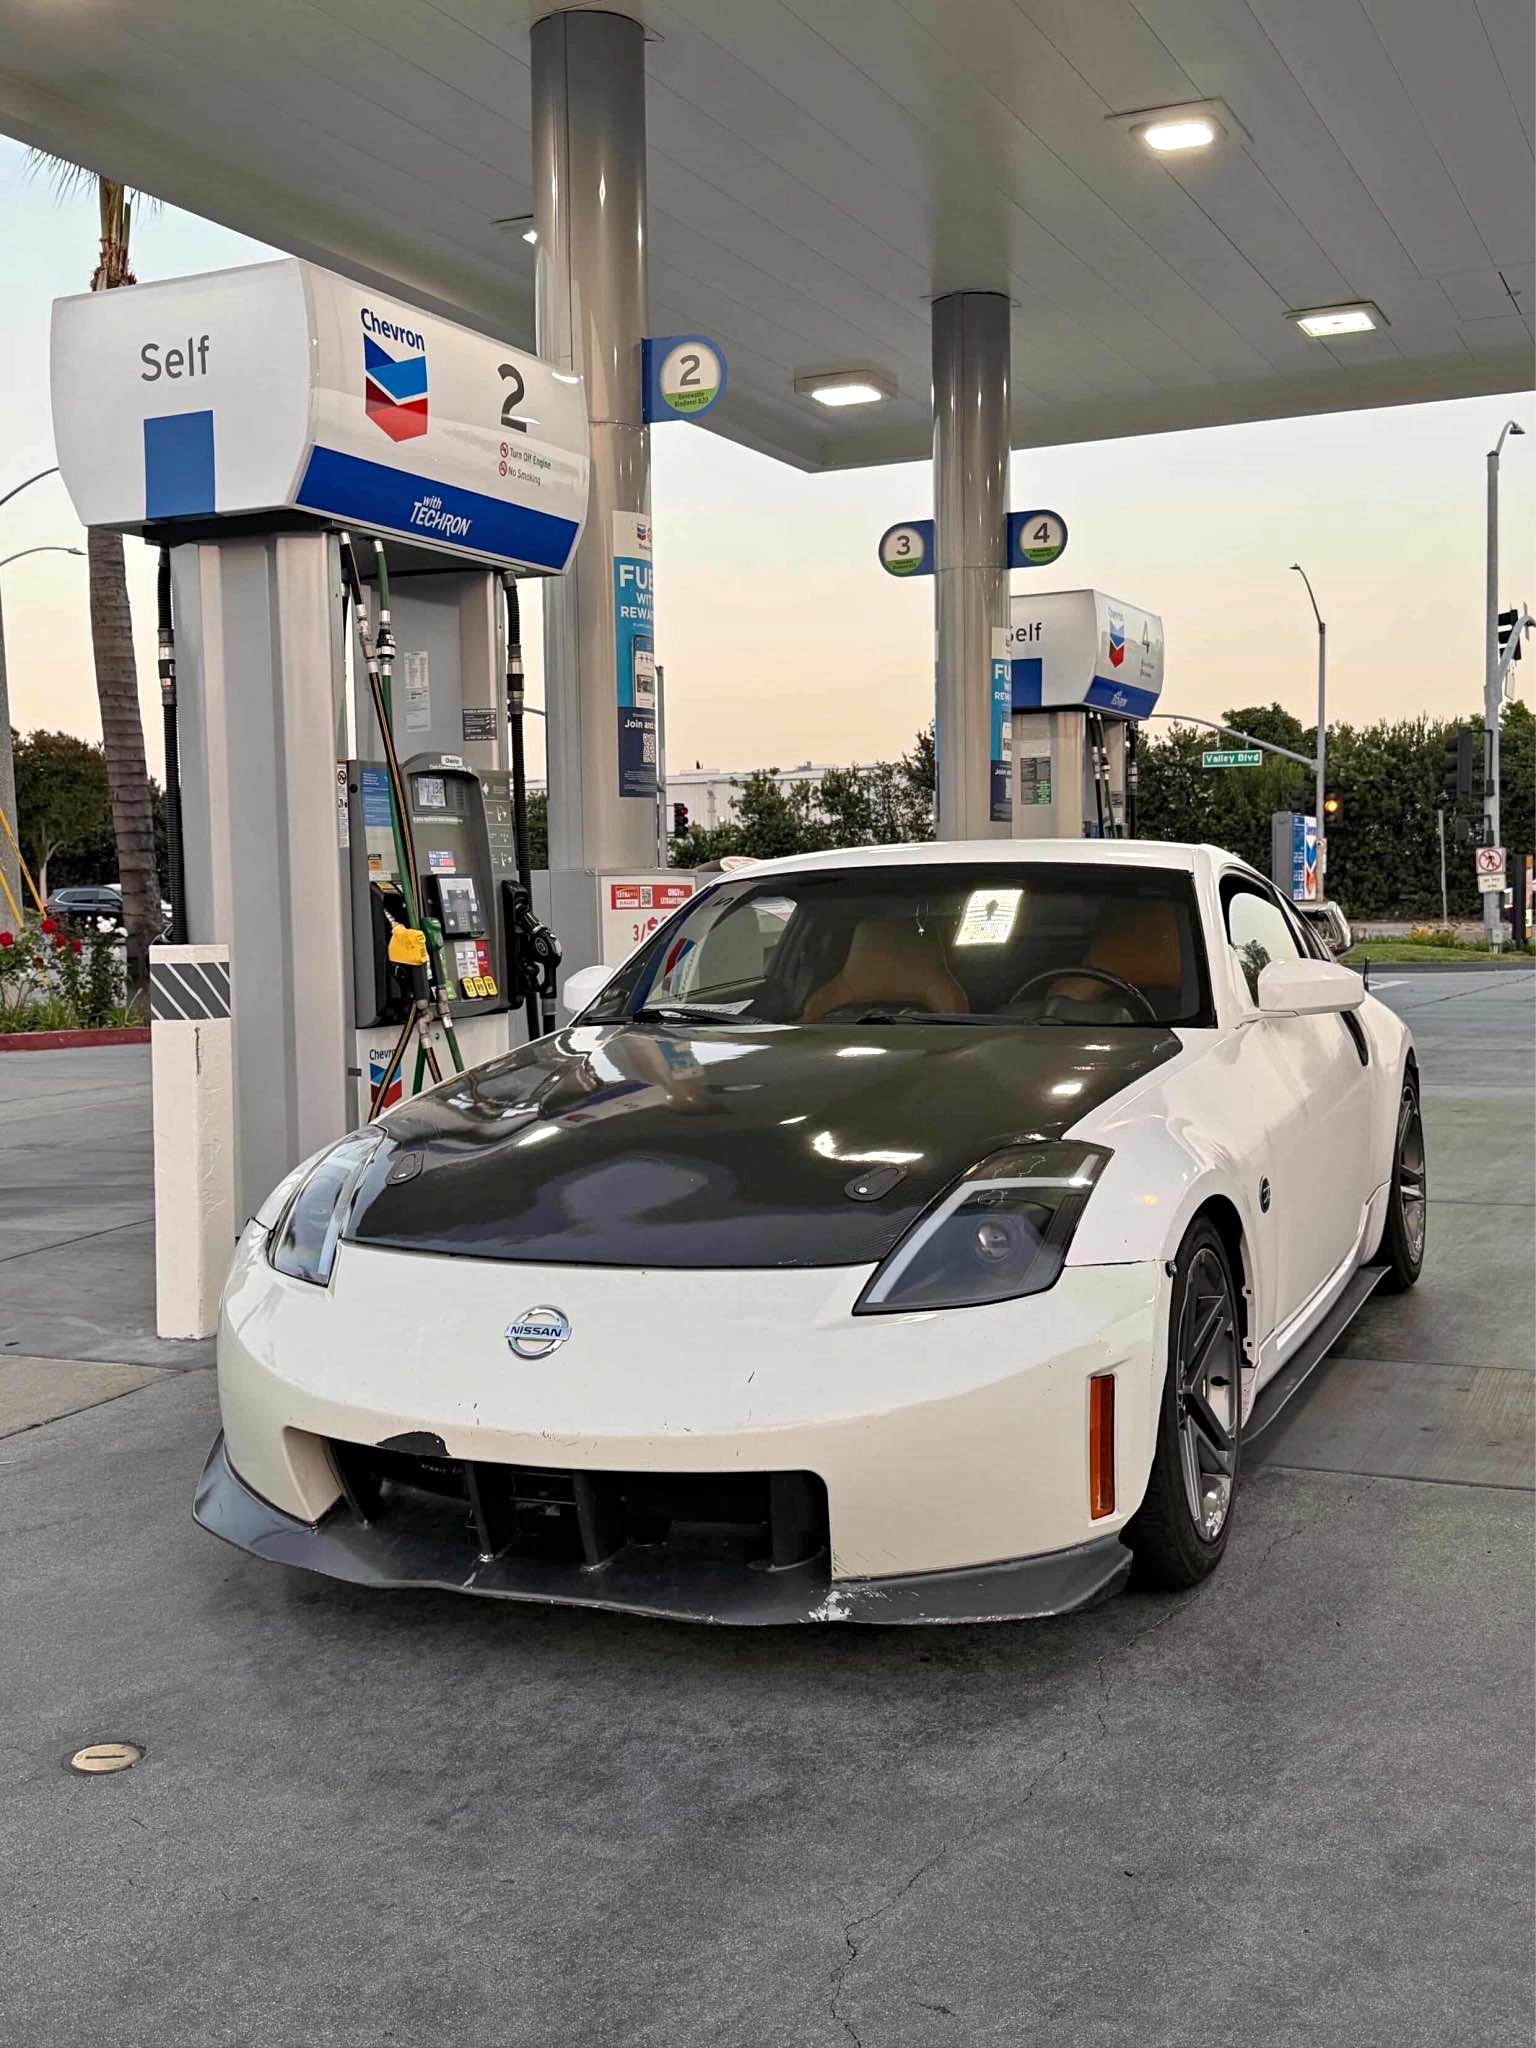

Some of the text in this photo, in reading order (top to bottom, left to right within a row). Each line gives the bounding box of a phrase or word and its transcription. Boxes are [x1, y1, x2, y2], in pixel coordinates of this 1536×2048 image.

[361, 308, 426, 352] Chevron
[141, 334, 210, 381] Self
[680, 354, 701, 387] 2
[498, 363, 527, 433] 2
[510, 447, 552, 469] Turn Off Engine
[508, 466, 541, 486] No Smoking
[423, 495, 442, 510] with
[410, 502, 471, 537] TECHRON
[1033, 522, 1050, 544] 4
[896, 535, 911, 556] 3
[1142, 620, 1150, 655] 4
[624, 719, 643, 729] Join
[1206, 753, 1259, 764] Valley Blvd
[510, 1326, 562, 1337] NISSAN
